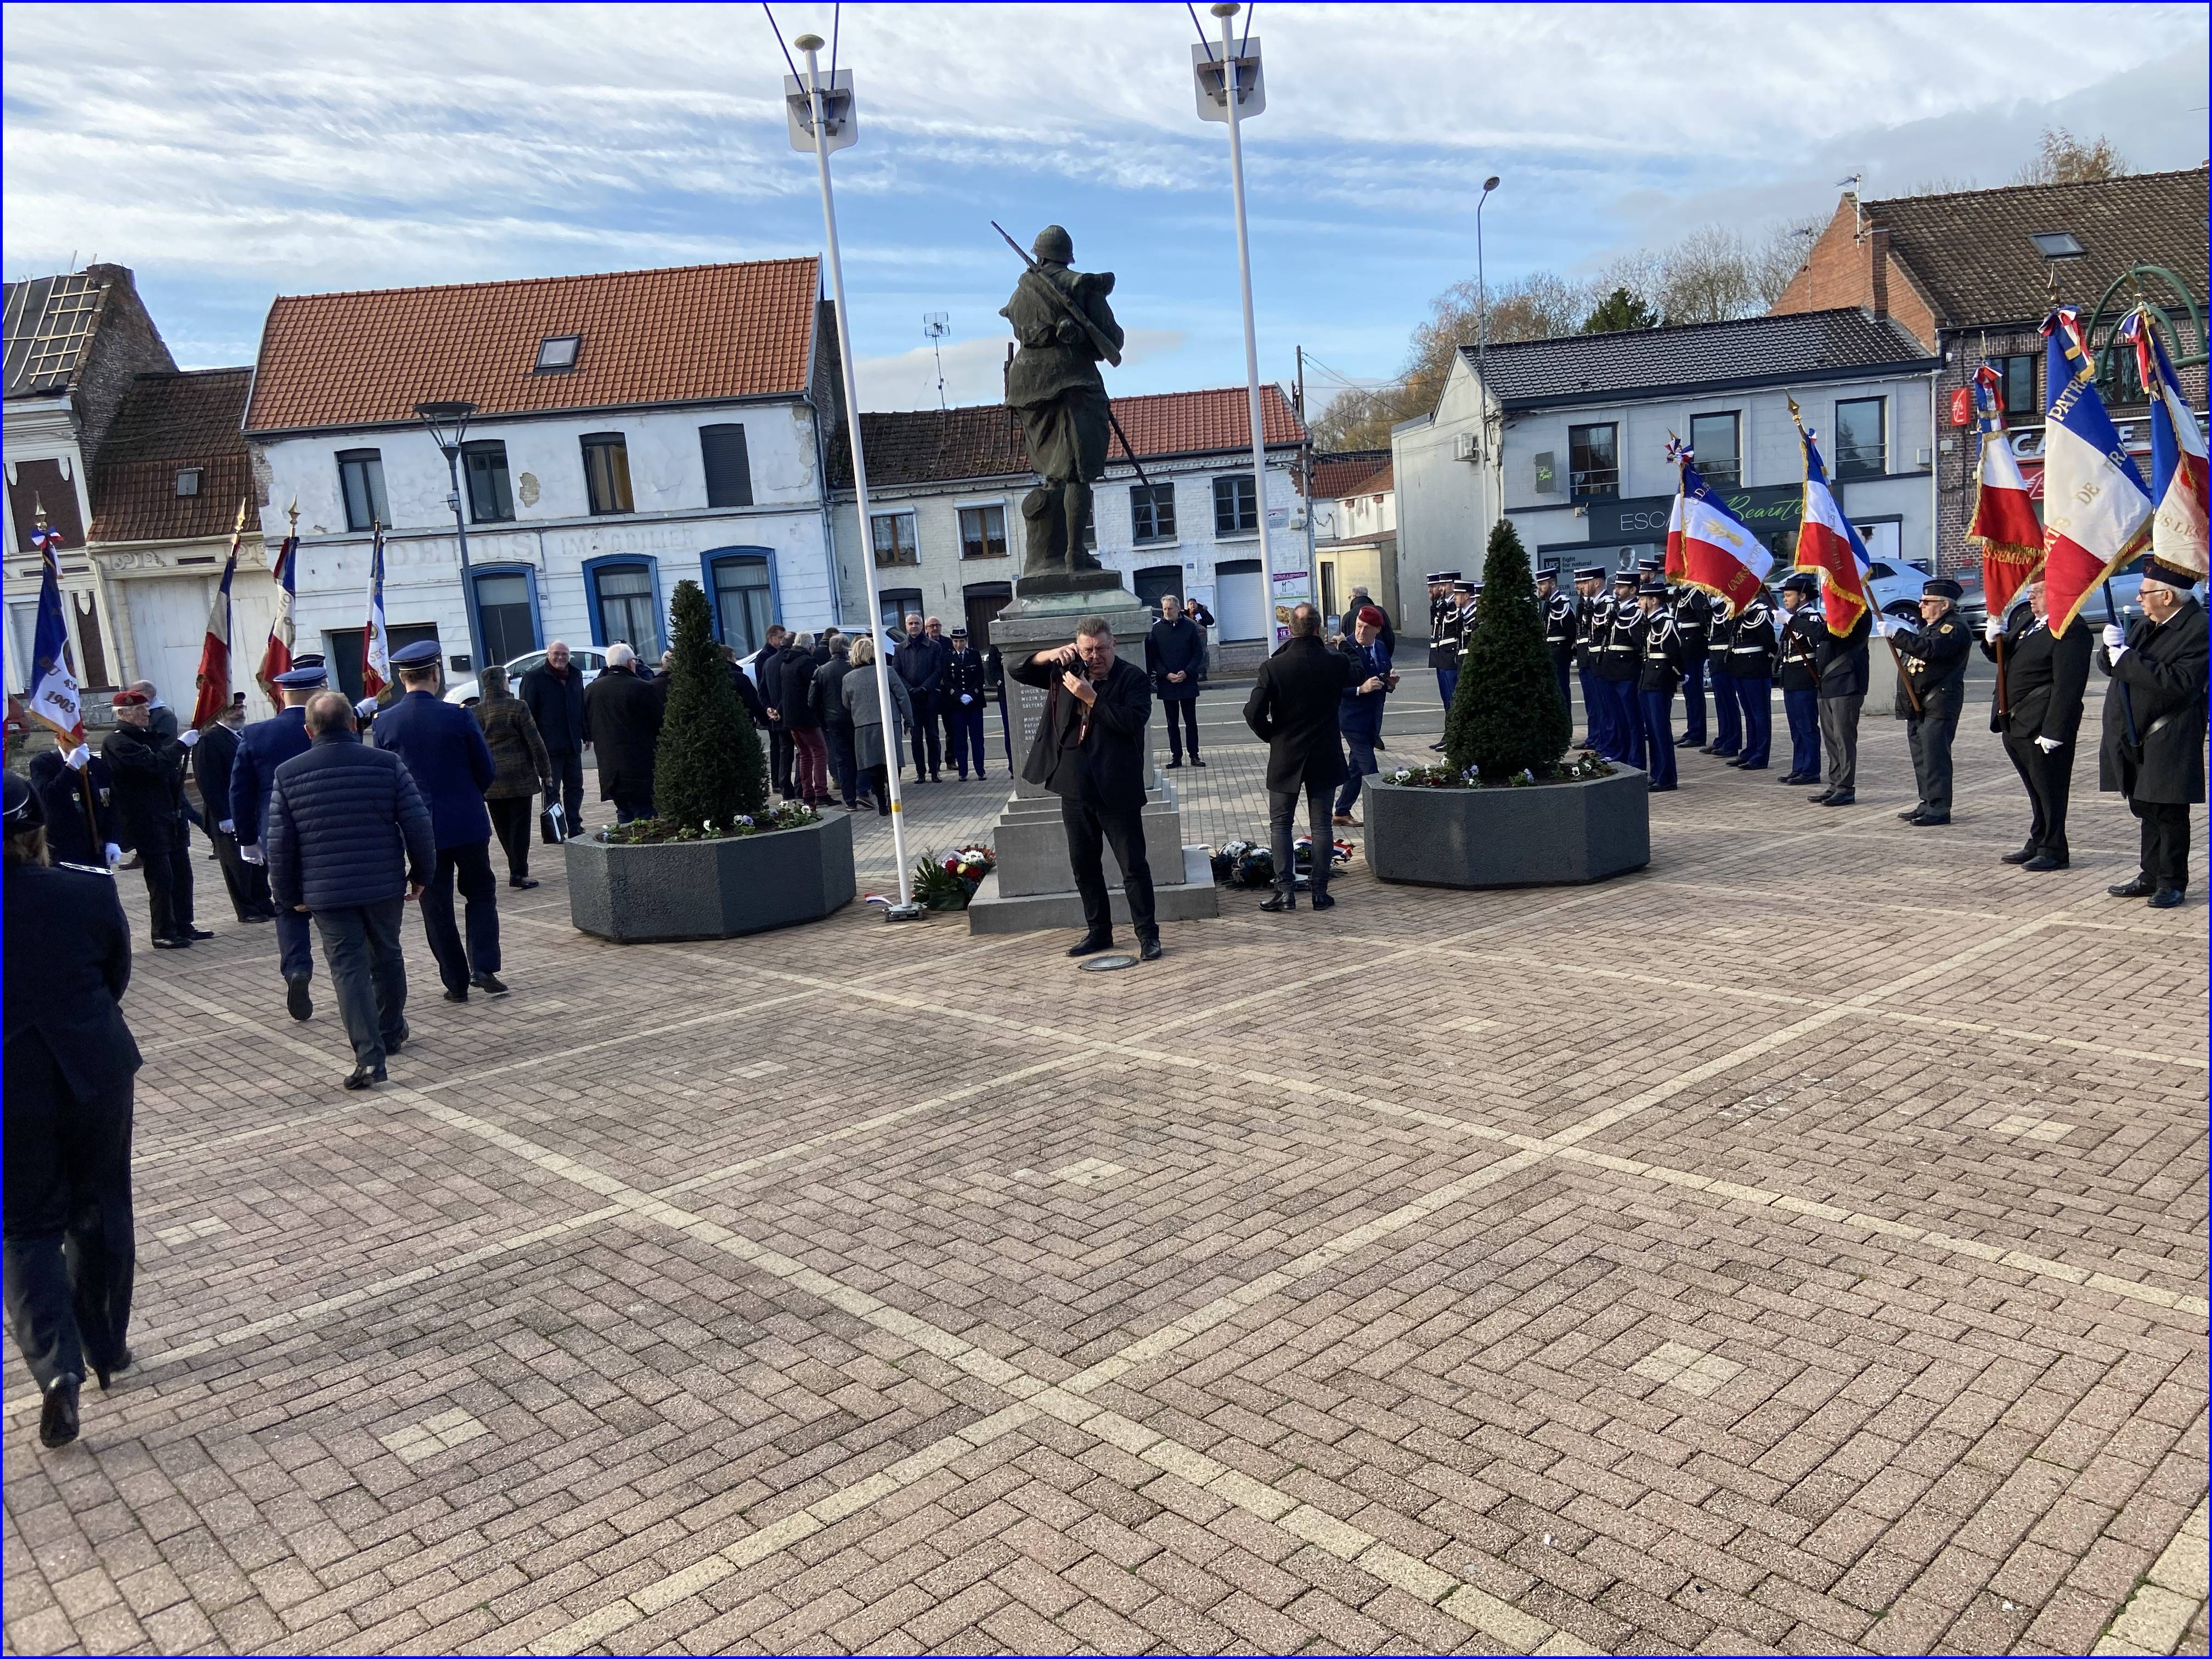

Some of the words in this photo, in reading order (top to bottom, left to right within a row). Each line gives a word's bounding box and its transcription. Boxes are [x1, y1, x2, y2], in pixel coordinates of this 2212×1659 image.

[2074, 482, 2100, 505] DE
[2173, 521, 2202, 538] LES
[44, 691, 76, 713] 1903
